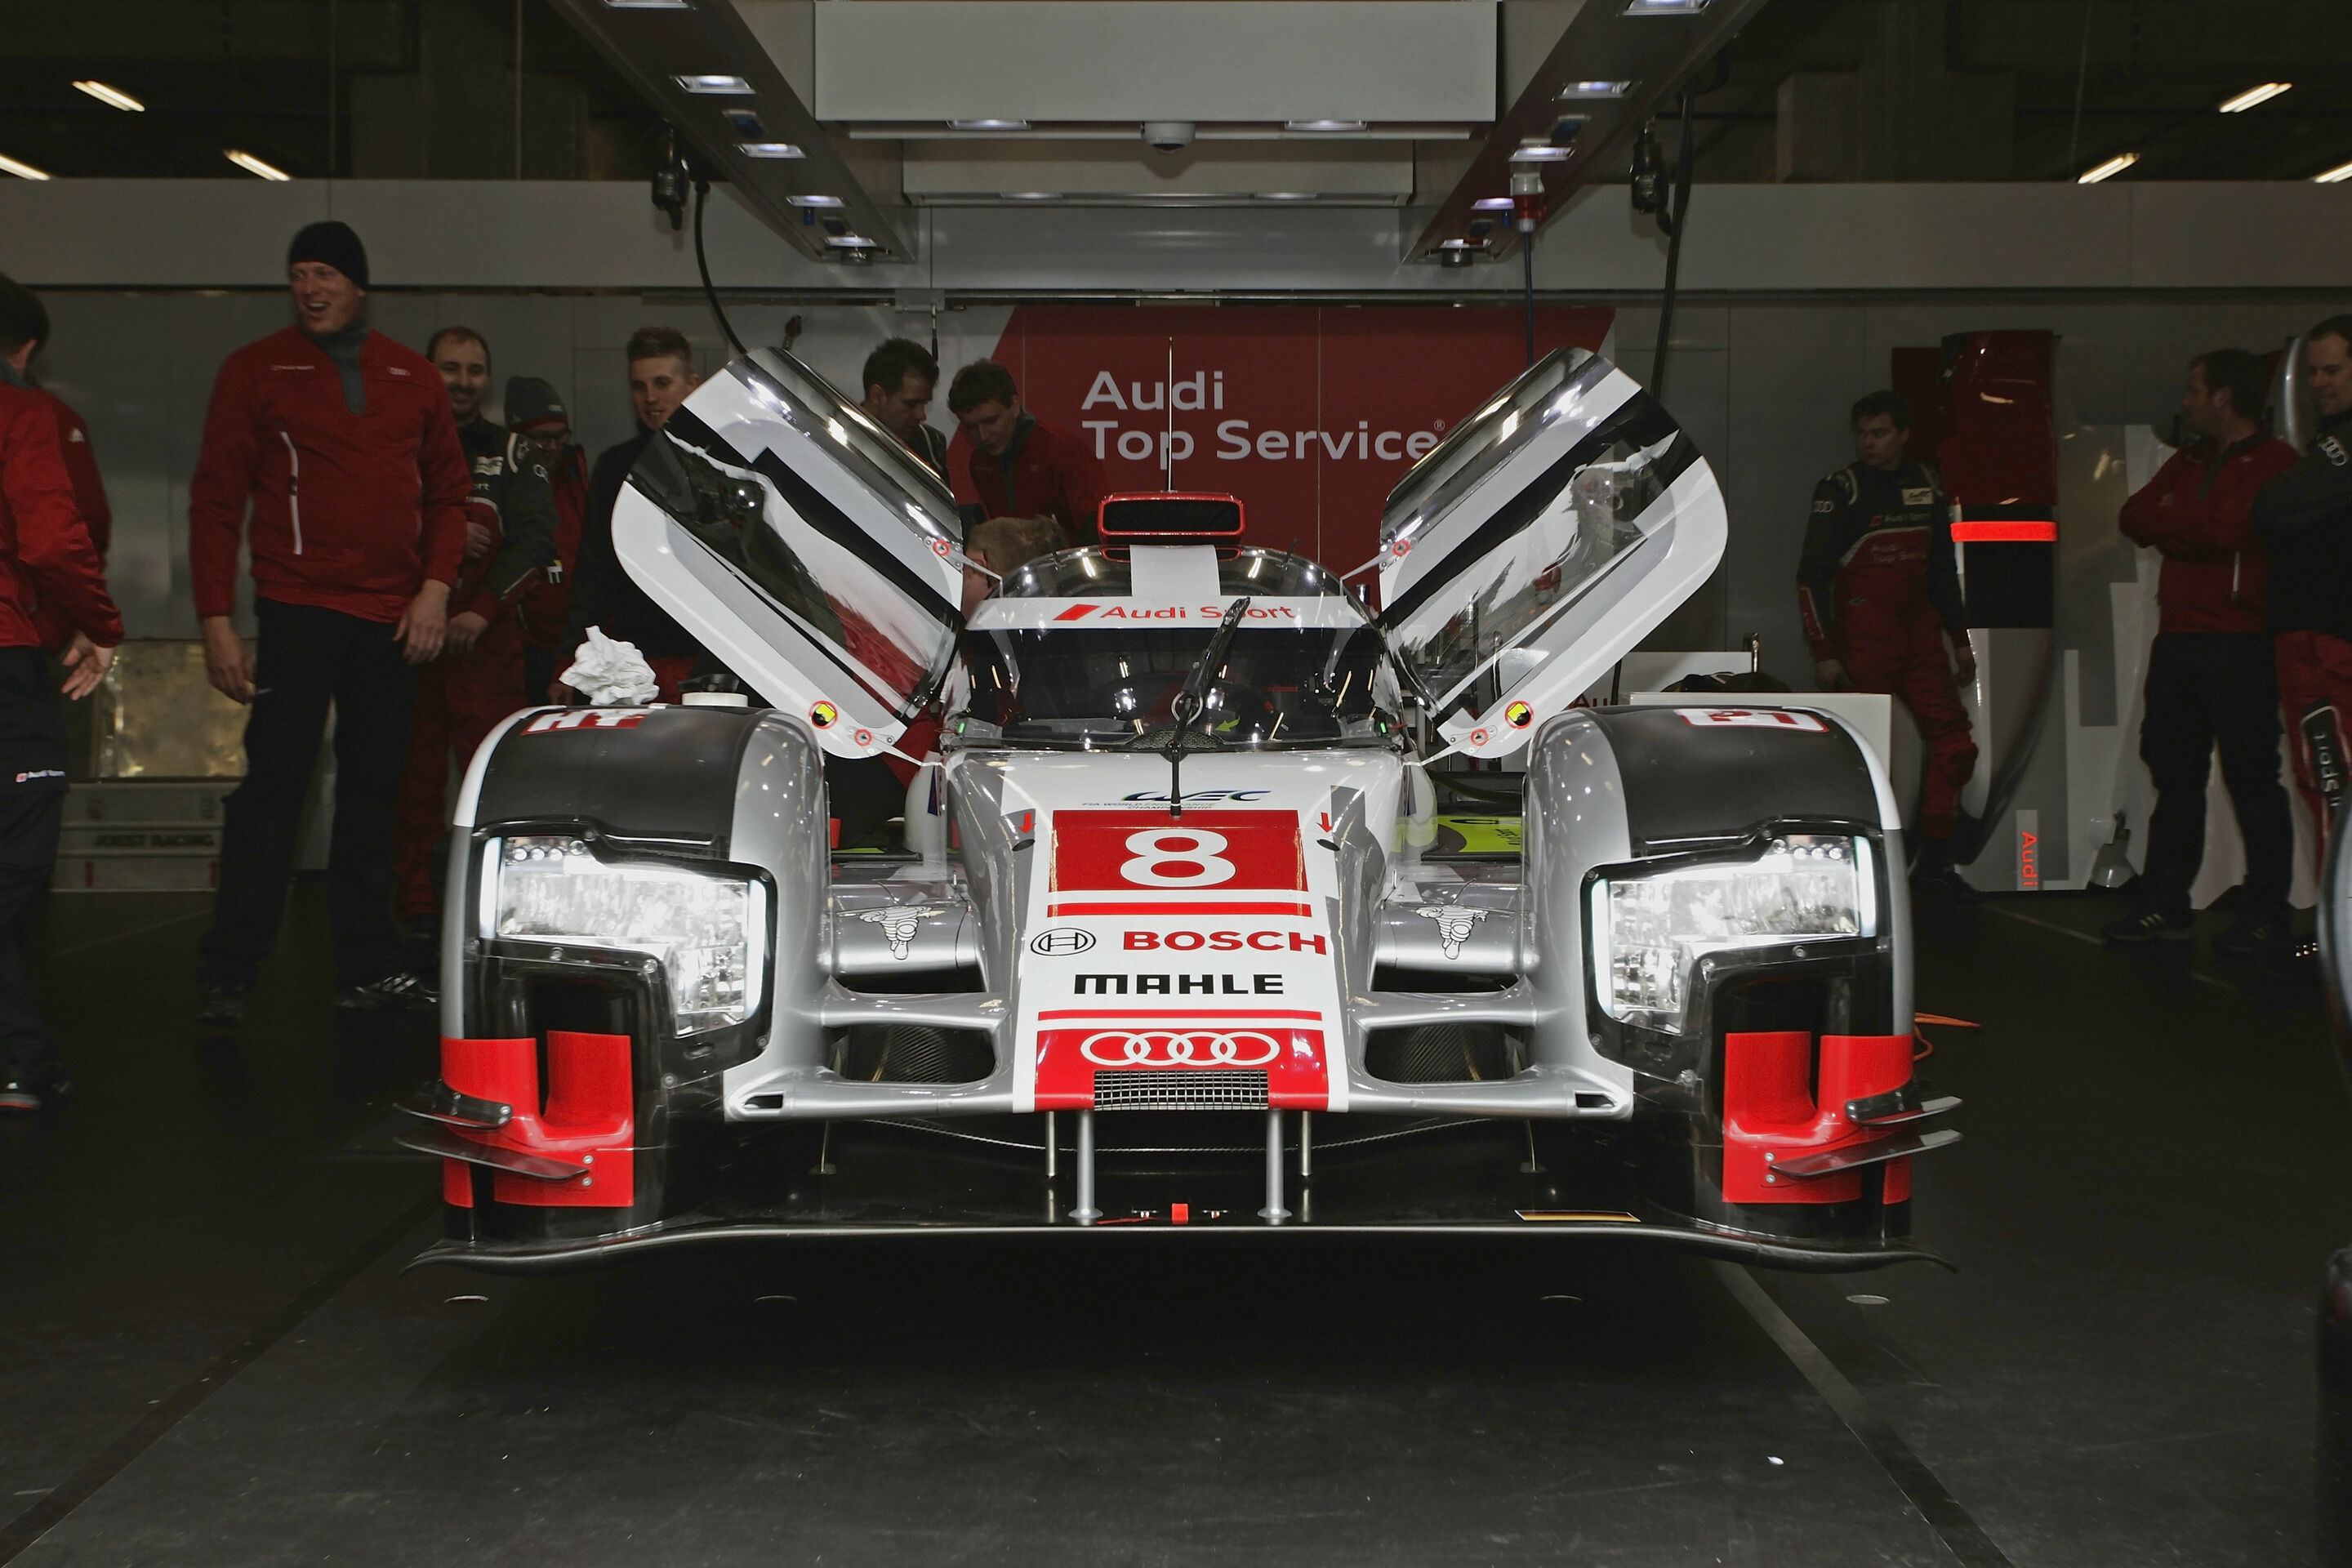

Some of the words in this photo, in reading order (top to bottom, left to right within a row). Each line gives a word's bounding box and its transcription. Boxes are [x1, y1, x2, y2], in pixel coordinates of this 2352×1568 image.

[1080, 370, 1224, 411] Audi
[1081, 420, 1195, 470] Top
[1099, 605, 1187, 619] Audi
[527, 708, 648, 733] HY
[150, 834, 215, 847] RACING
[1119, 827, 1237, 888] 8
[2020, 830, 2039, 887] Audi
[1123, 930, 1327, 956] BOSCH
[1073, 973, 1285, 996] MAHLE
